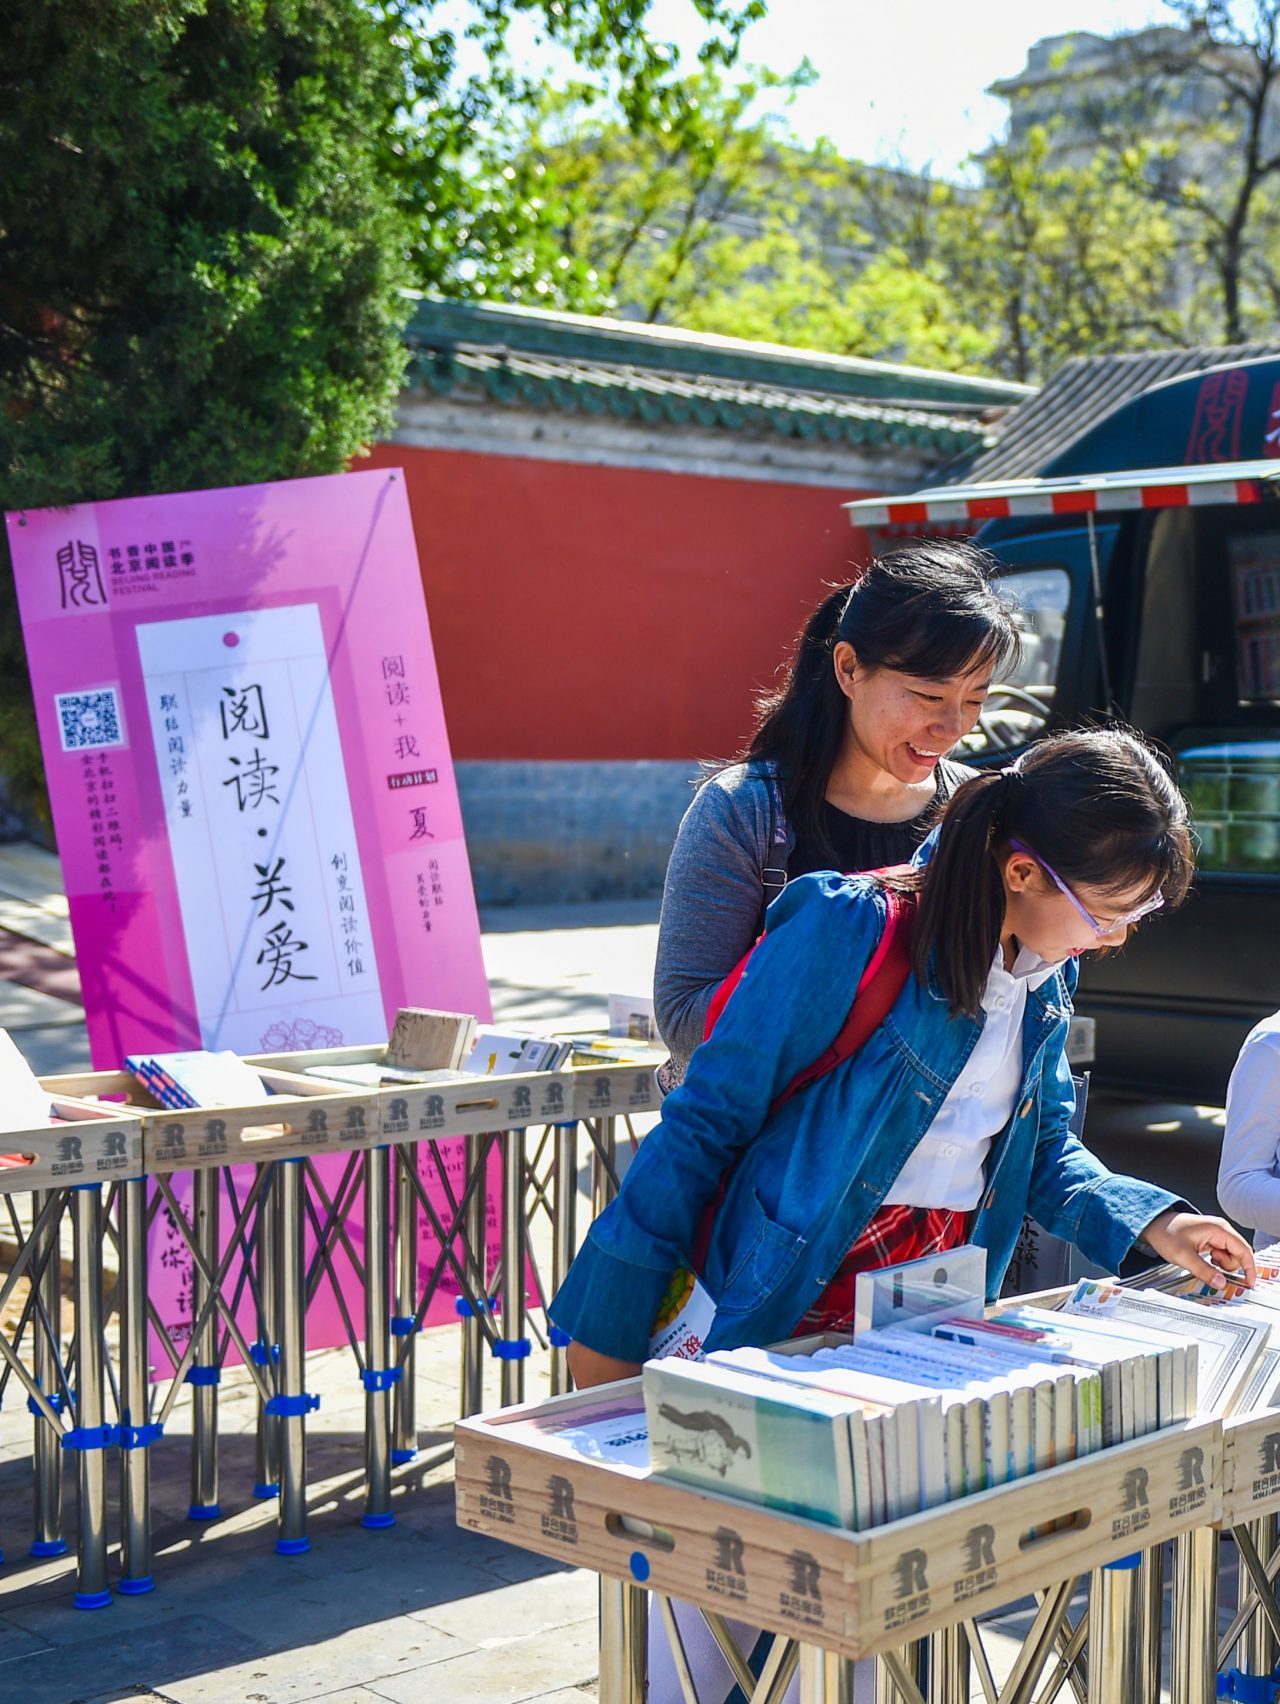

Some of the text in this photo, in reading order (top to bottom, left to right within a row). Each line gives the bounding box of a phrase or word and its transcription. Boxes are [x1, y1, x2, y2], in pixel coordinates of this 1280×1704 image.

[109, 541, 175, 559] 书香中国
[111, 552, 194, 575] 北京阅读季
[409, 806, 435, 841] 夏
[547, 1082, 564, 1103] R
[595, 1077, 611, 1097] R
[634, 1073, 650, 1092] R
[424, 1094, 444, 1117] R
[513, 1085, 531, 1106] R
[307, 1109, 328, 1131] R
[346, 1106, 366, 1128] R
[387, 1098, 408, 1120] R
[162, 1123, 185, 1147] R
[205, 1119, 227, 1142] R
[56, 1136, 83, 1161] R
[101, 1132, 127, 1156] R
[483, 1455, 513, 1500] R
[1175, 1447, 1204, 1492] R
[546, 1474, 576, 1521] R
[1117, 1467, 1149, 1512] R
[713, 1525, 746, 1576] R
[961, 1524, 996, 1573] R
[786, 1549, 822, 1600] R
[891, 1548, 929, 1599] R
